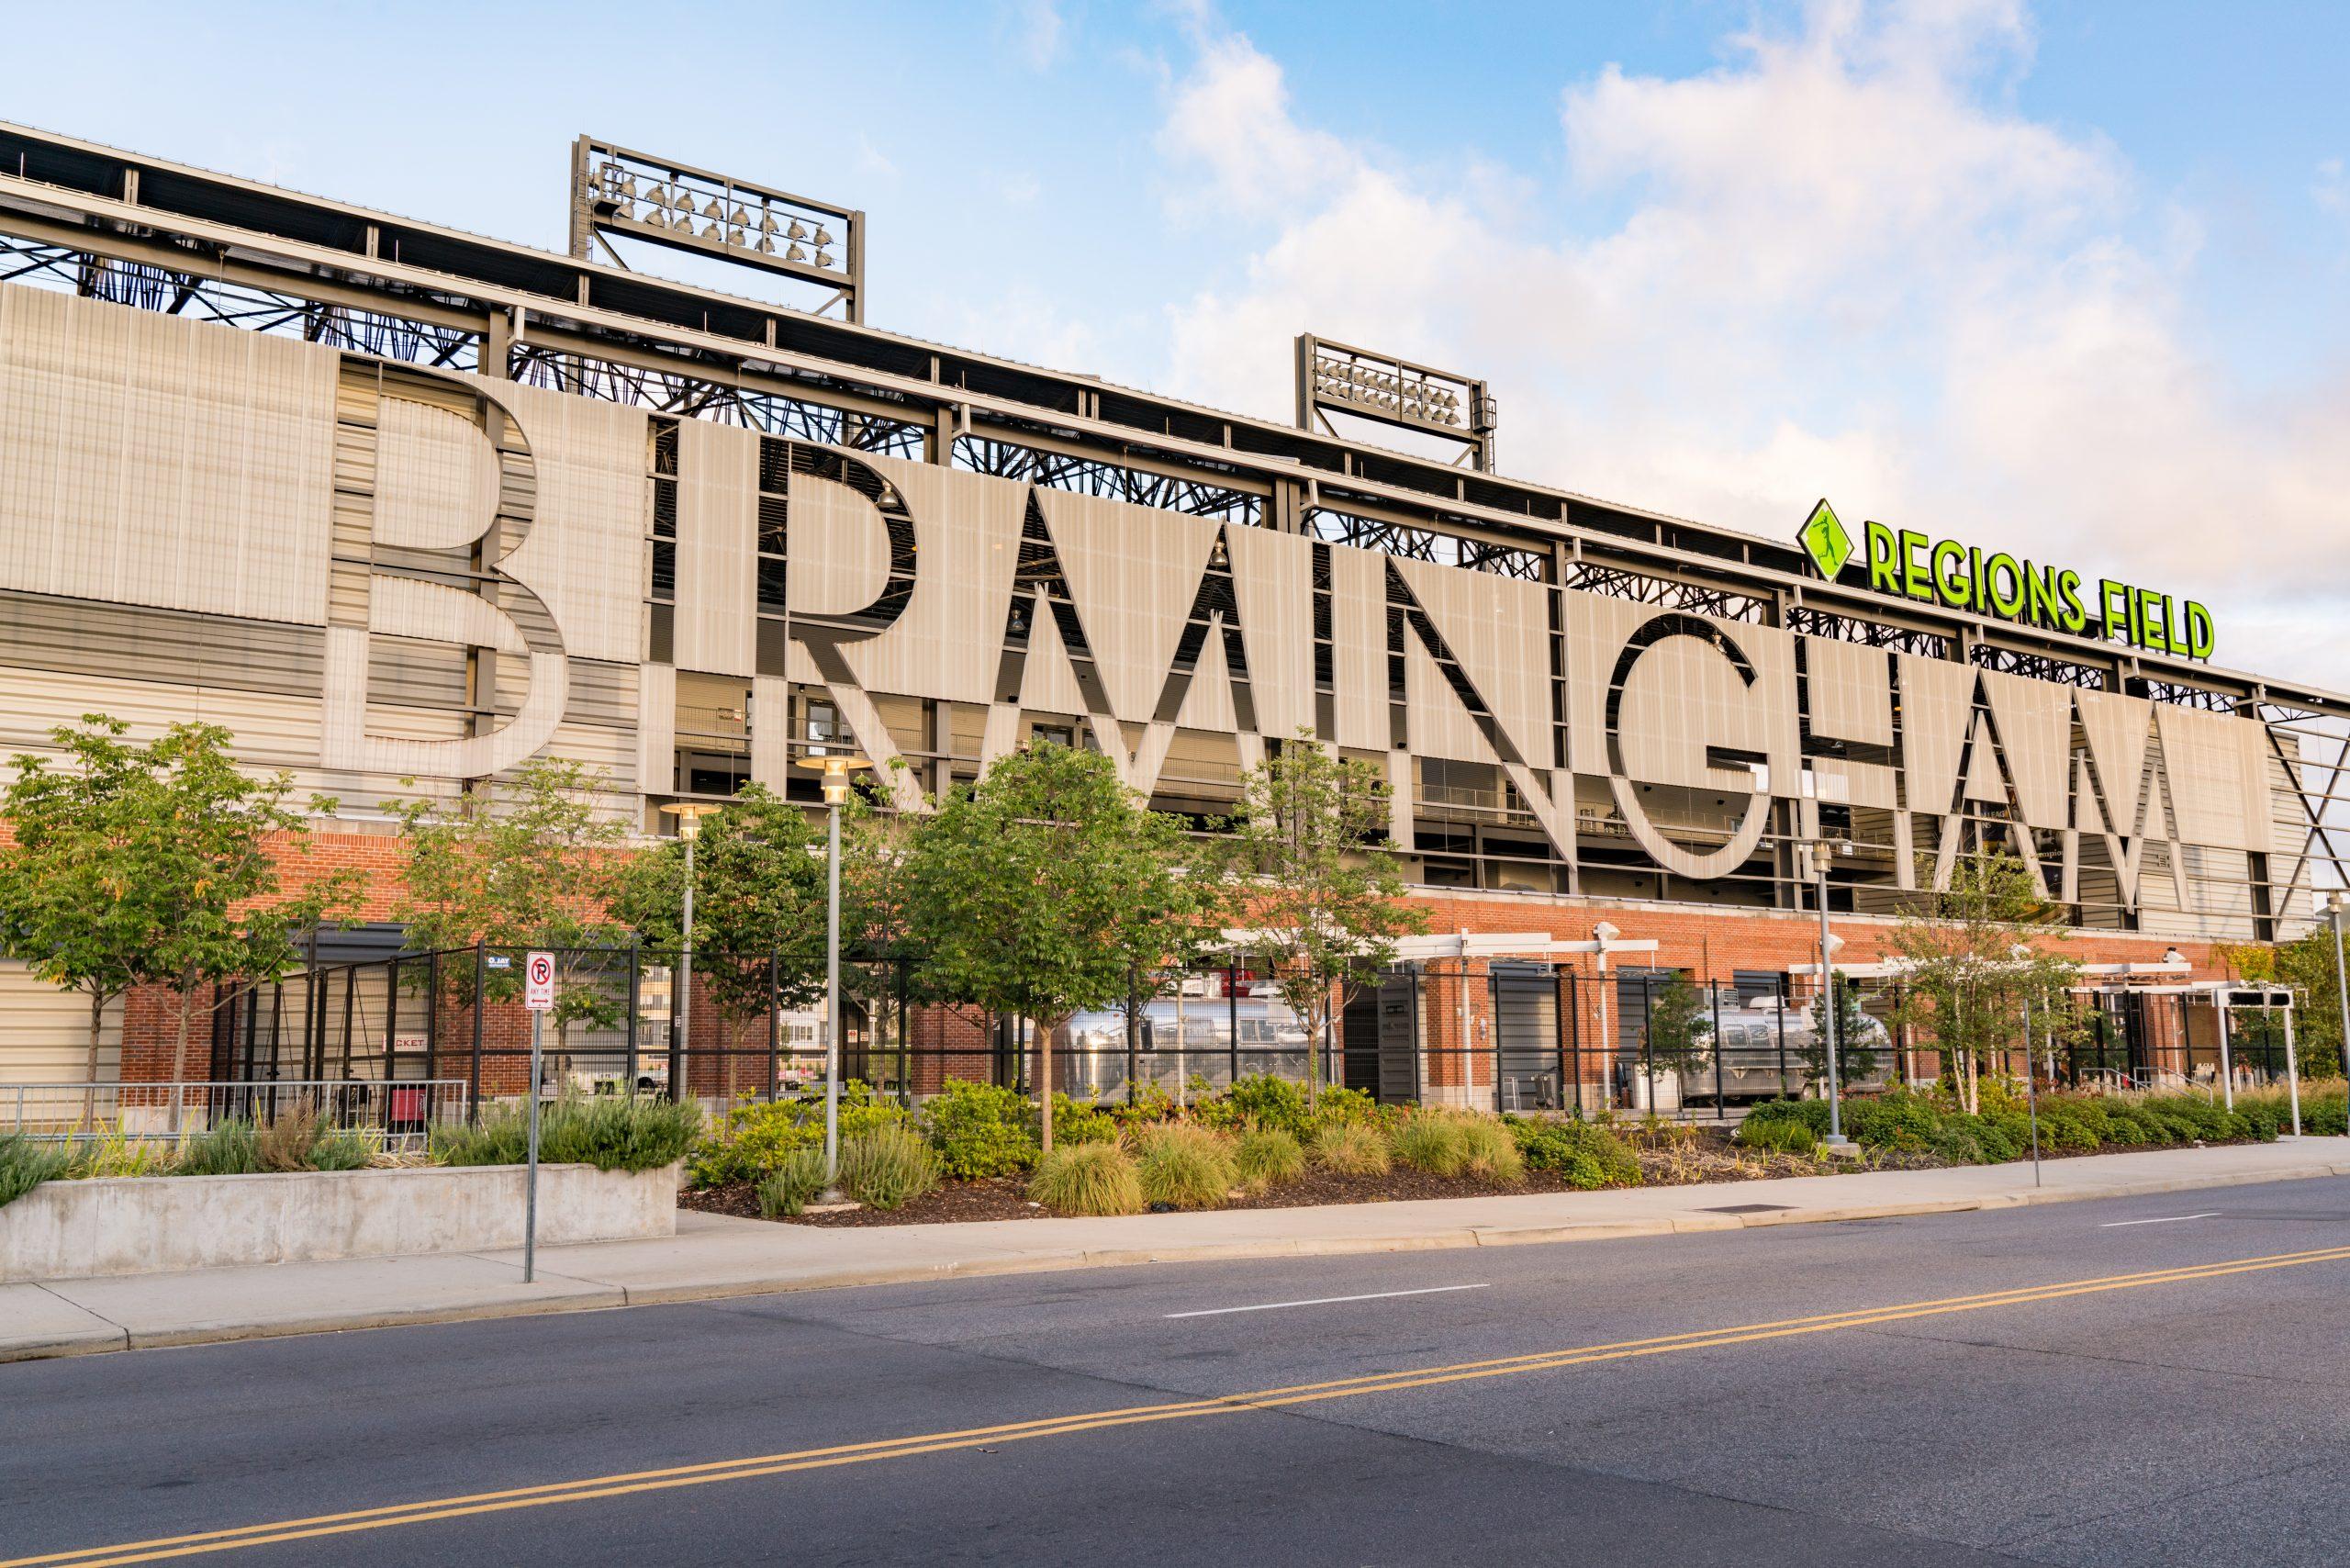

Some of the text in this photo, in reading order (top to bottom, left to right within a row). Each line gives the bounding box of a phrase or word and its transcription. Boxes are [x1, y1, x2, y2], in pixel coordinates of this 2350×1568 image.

[319, 352, 2193, 915] BIRMINGHAM
[1864, 521, 2215, 659] REGIONS FIELD
